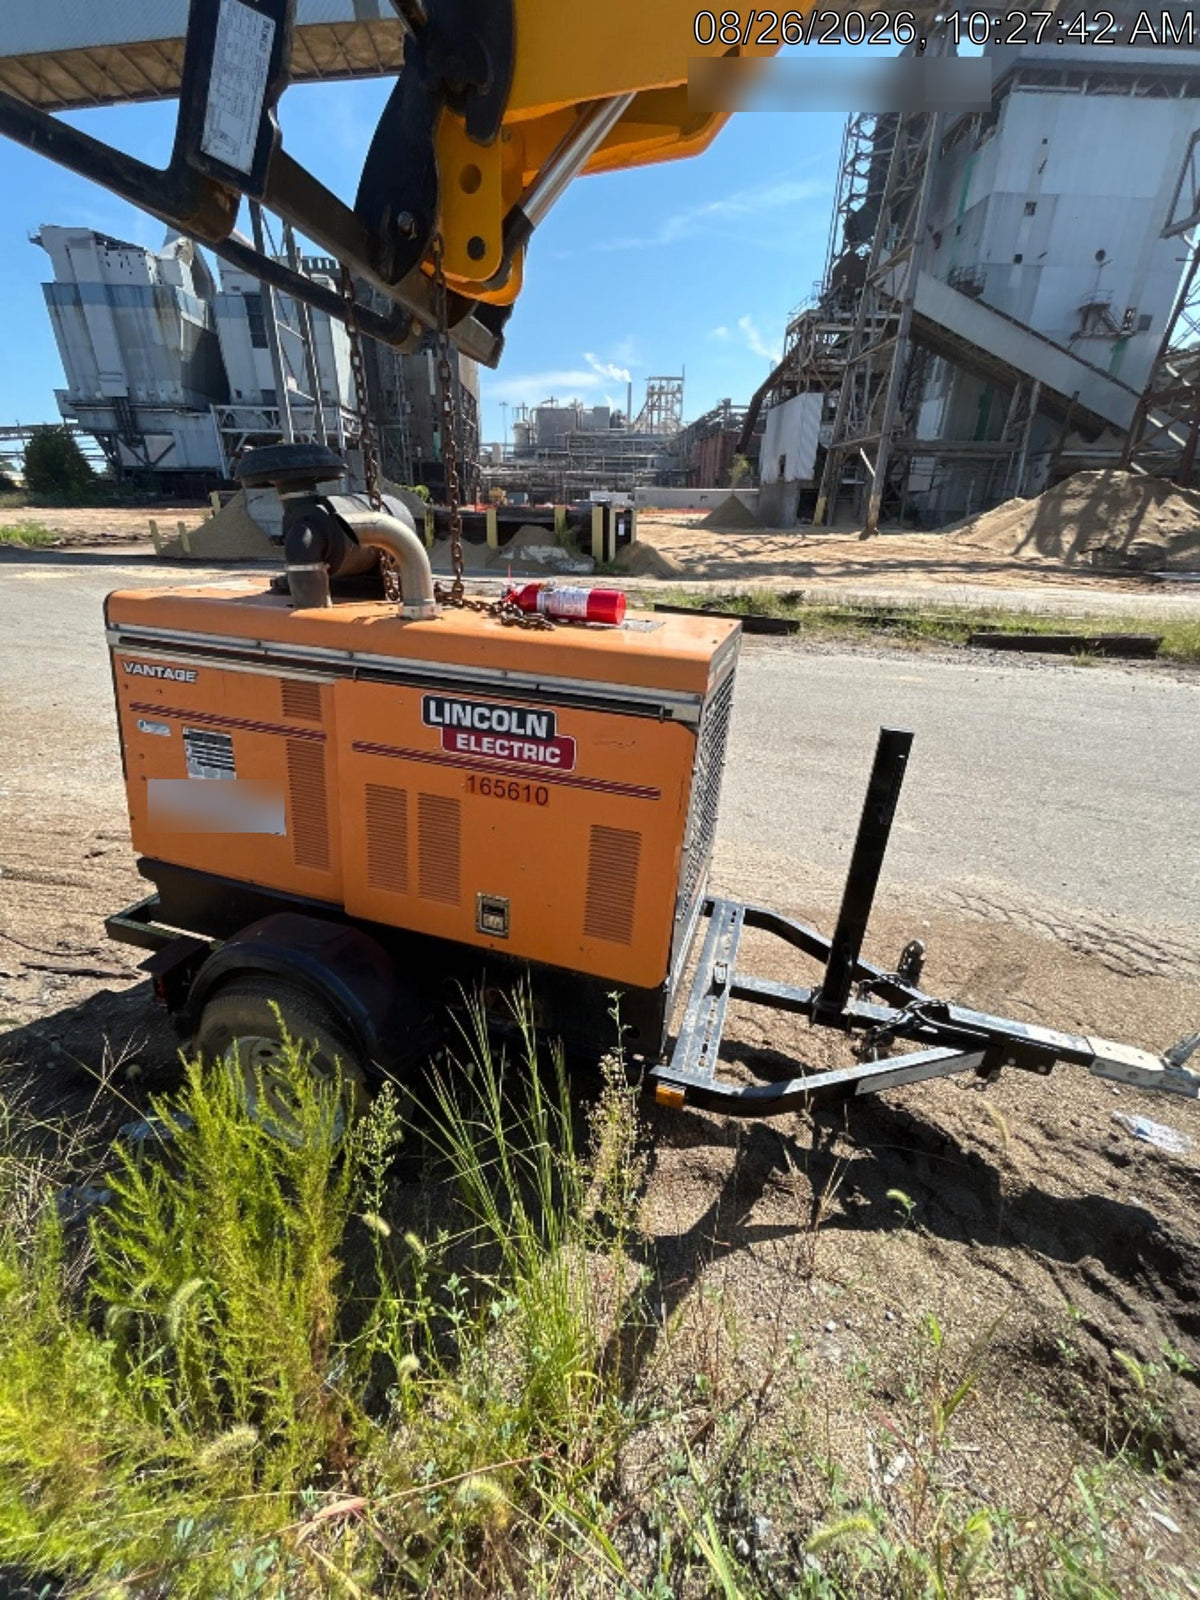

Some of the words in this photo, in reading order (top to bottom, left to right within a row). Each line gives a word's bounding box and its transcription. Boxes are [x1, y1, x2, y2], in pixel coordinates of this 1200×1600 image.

[122, 661, 198, 683] VANTAGE
[429, 700, 549, 739] LINCOLN
[456, 734, 562, 764] ELECTRIC
[467, 775, 550, 806] 165610
